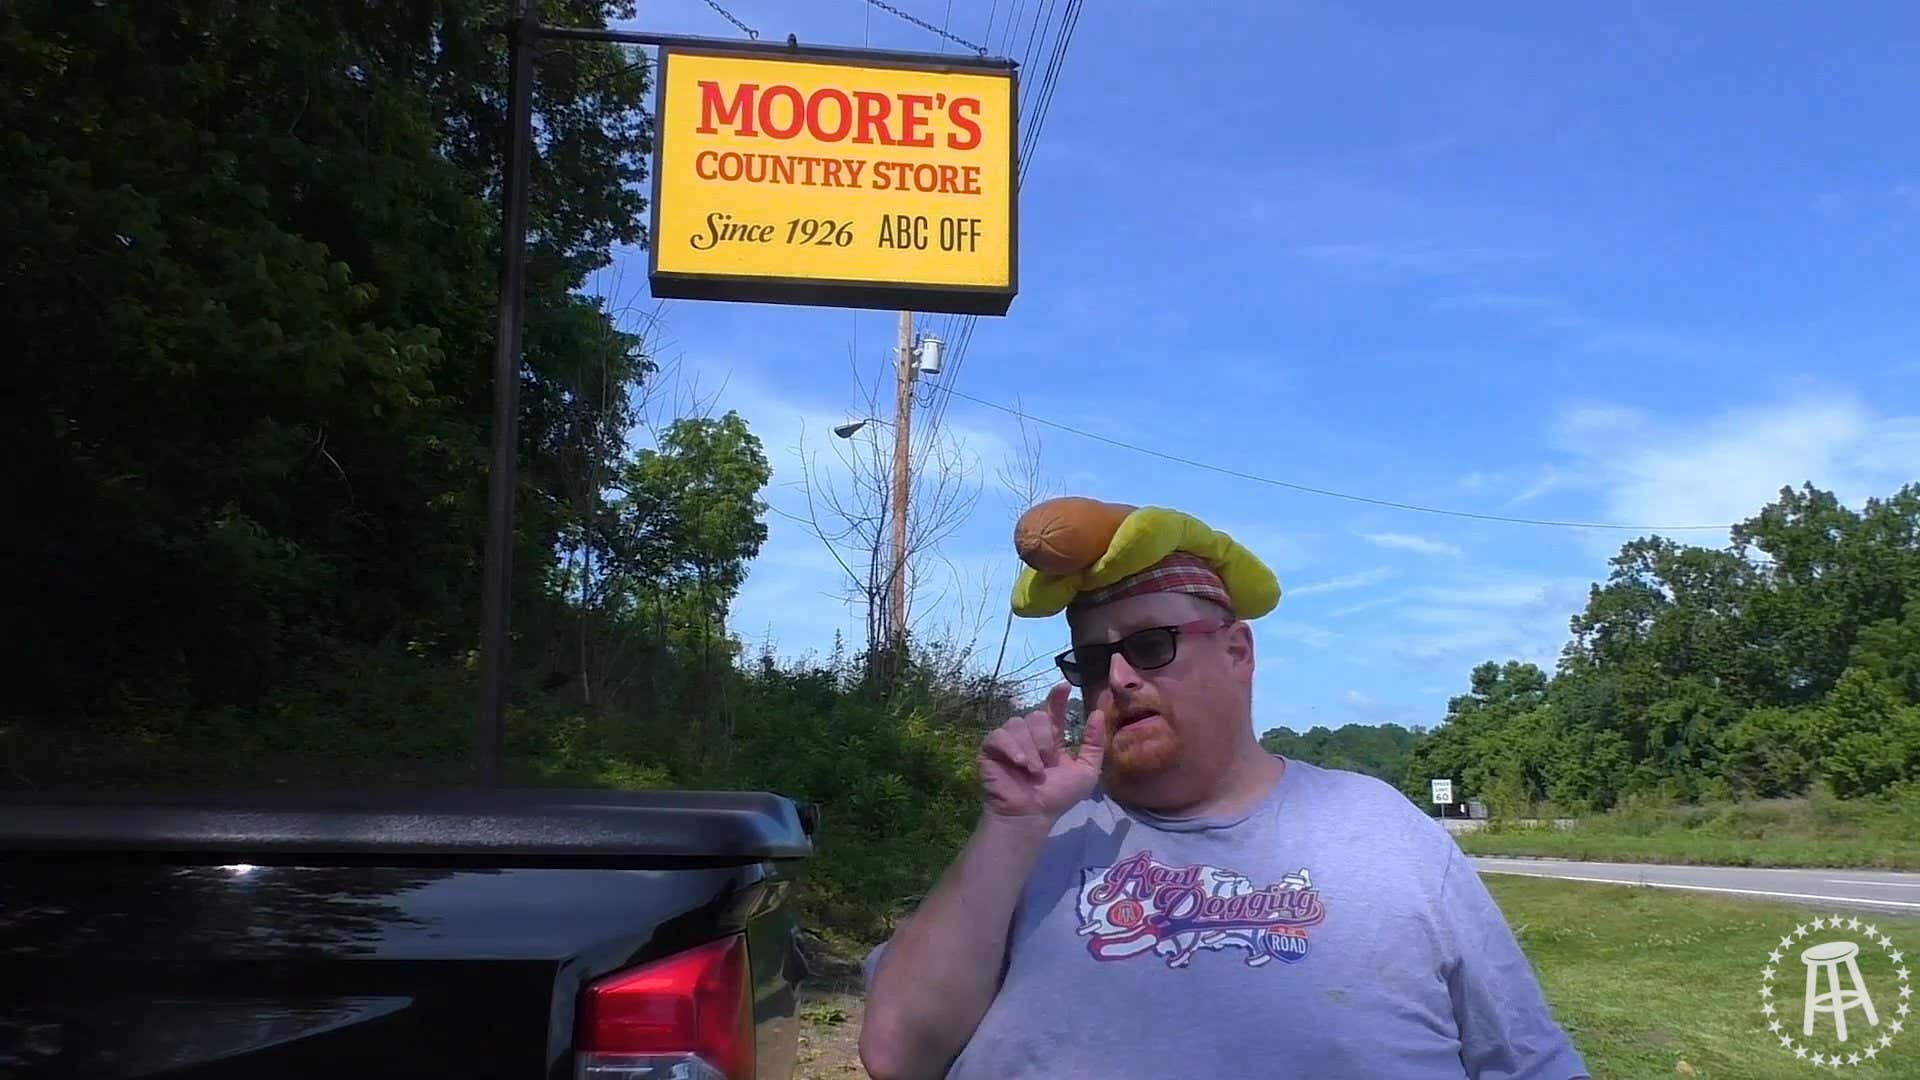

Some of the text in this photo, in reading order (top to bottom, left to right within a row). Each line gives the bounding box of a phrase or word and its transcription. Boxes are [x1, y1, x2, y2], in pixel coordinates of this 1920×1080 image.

[696, 80, 982, 151] MOORE'S
[695, 150, 981, 195] COUNTRY STORE
[690, 212, 981, 252] Since 1926 ABC OFF
[1271, 934, 1307, 954] ROAD
